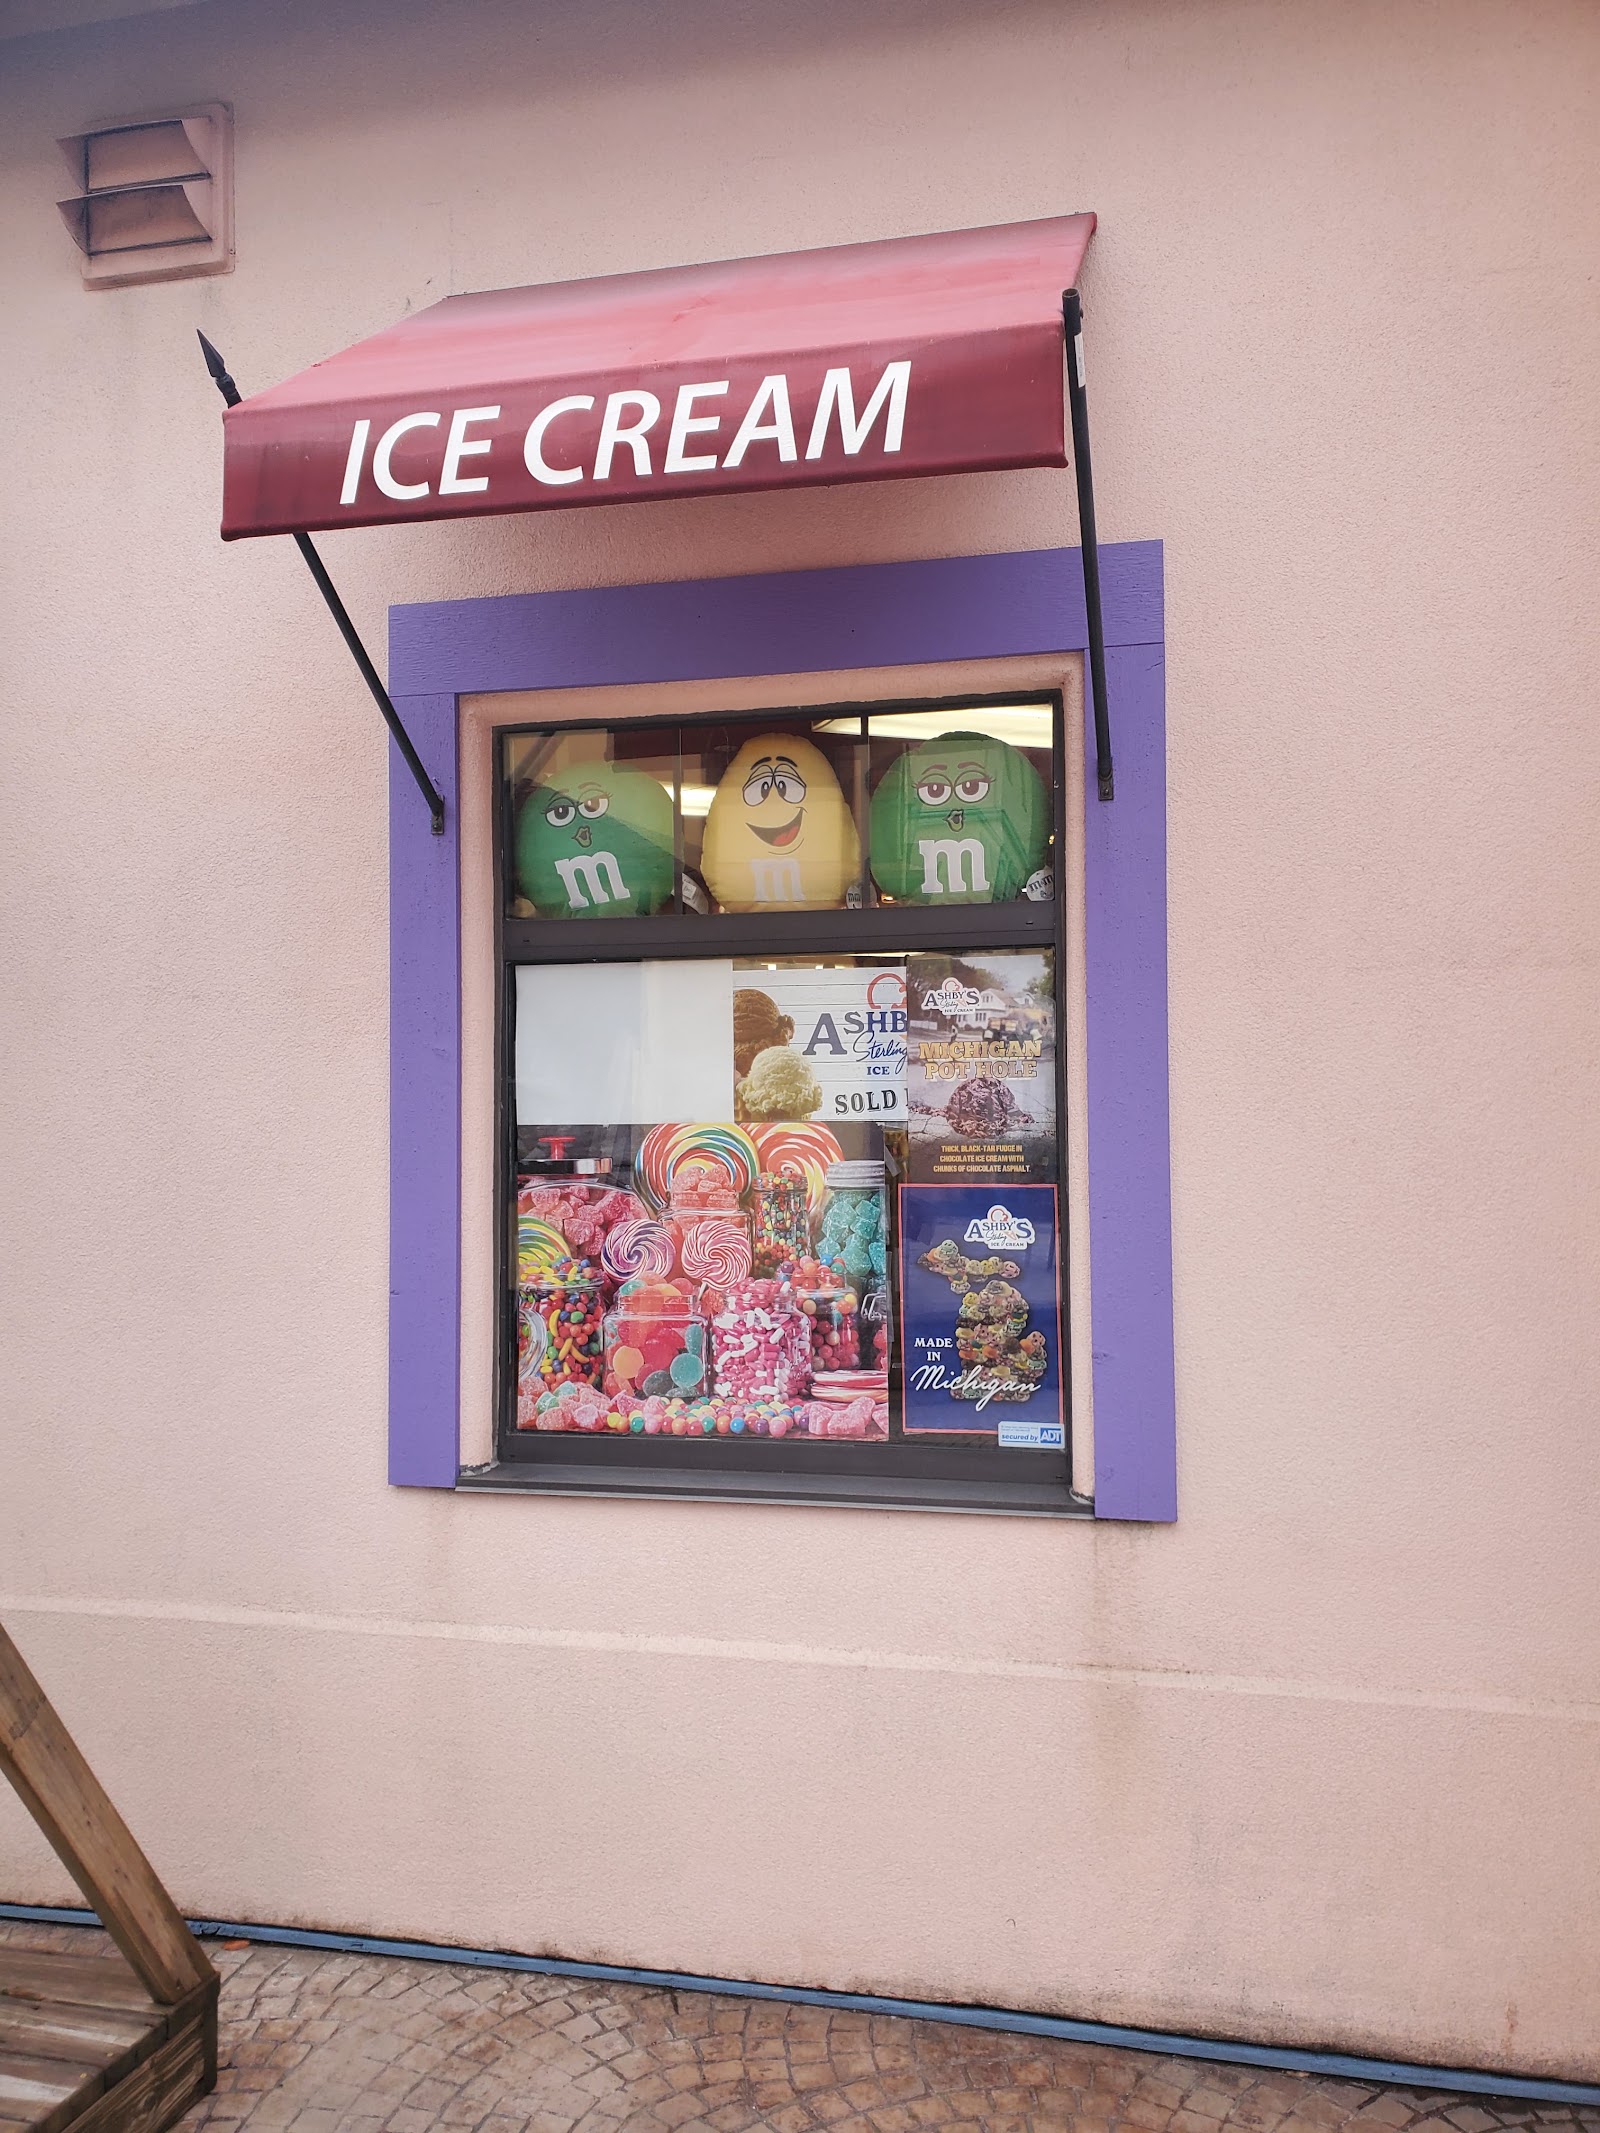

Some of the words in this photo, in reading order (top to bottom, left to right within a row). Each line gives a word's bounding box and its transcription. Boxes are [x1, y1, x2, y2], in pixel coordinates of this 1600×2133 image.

[340, 404, 503, 505] ICE
[524, 360, 912, 486] CREAM
[918, 838, 990, 893] m
[554, 850, 631, 909] m
[748, 857, 806, 903] m
[924, 990, 980, 1007] ASHBY'S
[802, 1010, 908, 1056] ASHB
[852, 1030, 908, 1075] Sterling
[918, 1040, 1042, 1060] MICHIGAN
[866, 1066, 891, 1076] ICE
[925, 1061, 970, 1080] POT
[975, 1060, 1038, 1079] HOLE
[834, 1089, 899, 1116] SOLD
[933, 1165, 957, 1173] CHUNKS
[967, 1220, 1032, 1239] ASHBY'S
[914, 1337, 953, 1348] MADE
[927, 1351, 941, 1361] IN
[910, 1364, 1041, 1412] Michigan
[1040, 1429, 1061, 1442] ADT
